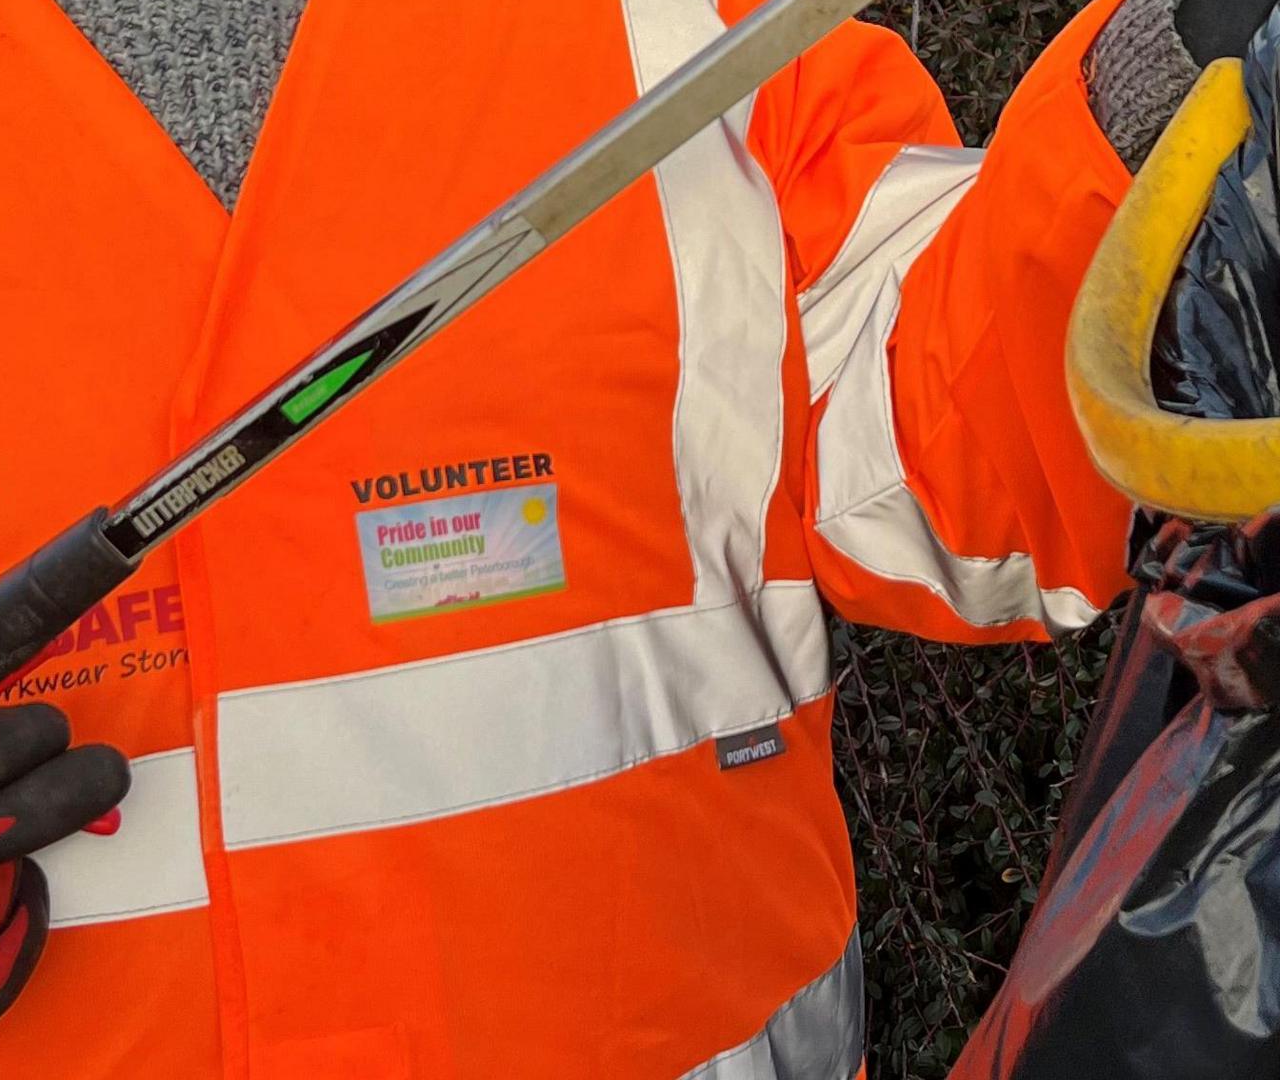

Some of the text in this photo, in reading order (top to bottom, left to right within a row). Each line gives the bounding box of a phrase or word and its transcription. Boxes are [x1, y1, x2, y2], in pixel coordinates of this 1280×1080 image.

[351, 452, 555, 504] VOLUNTEER
[376, 511, 482, 546] Pride in our
[380, 533, 486, 569] Community
[3, 663, 109, 701] rkwear
[726, 738, 778, 766] PORTWEST
